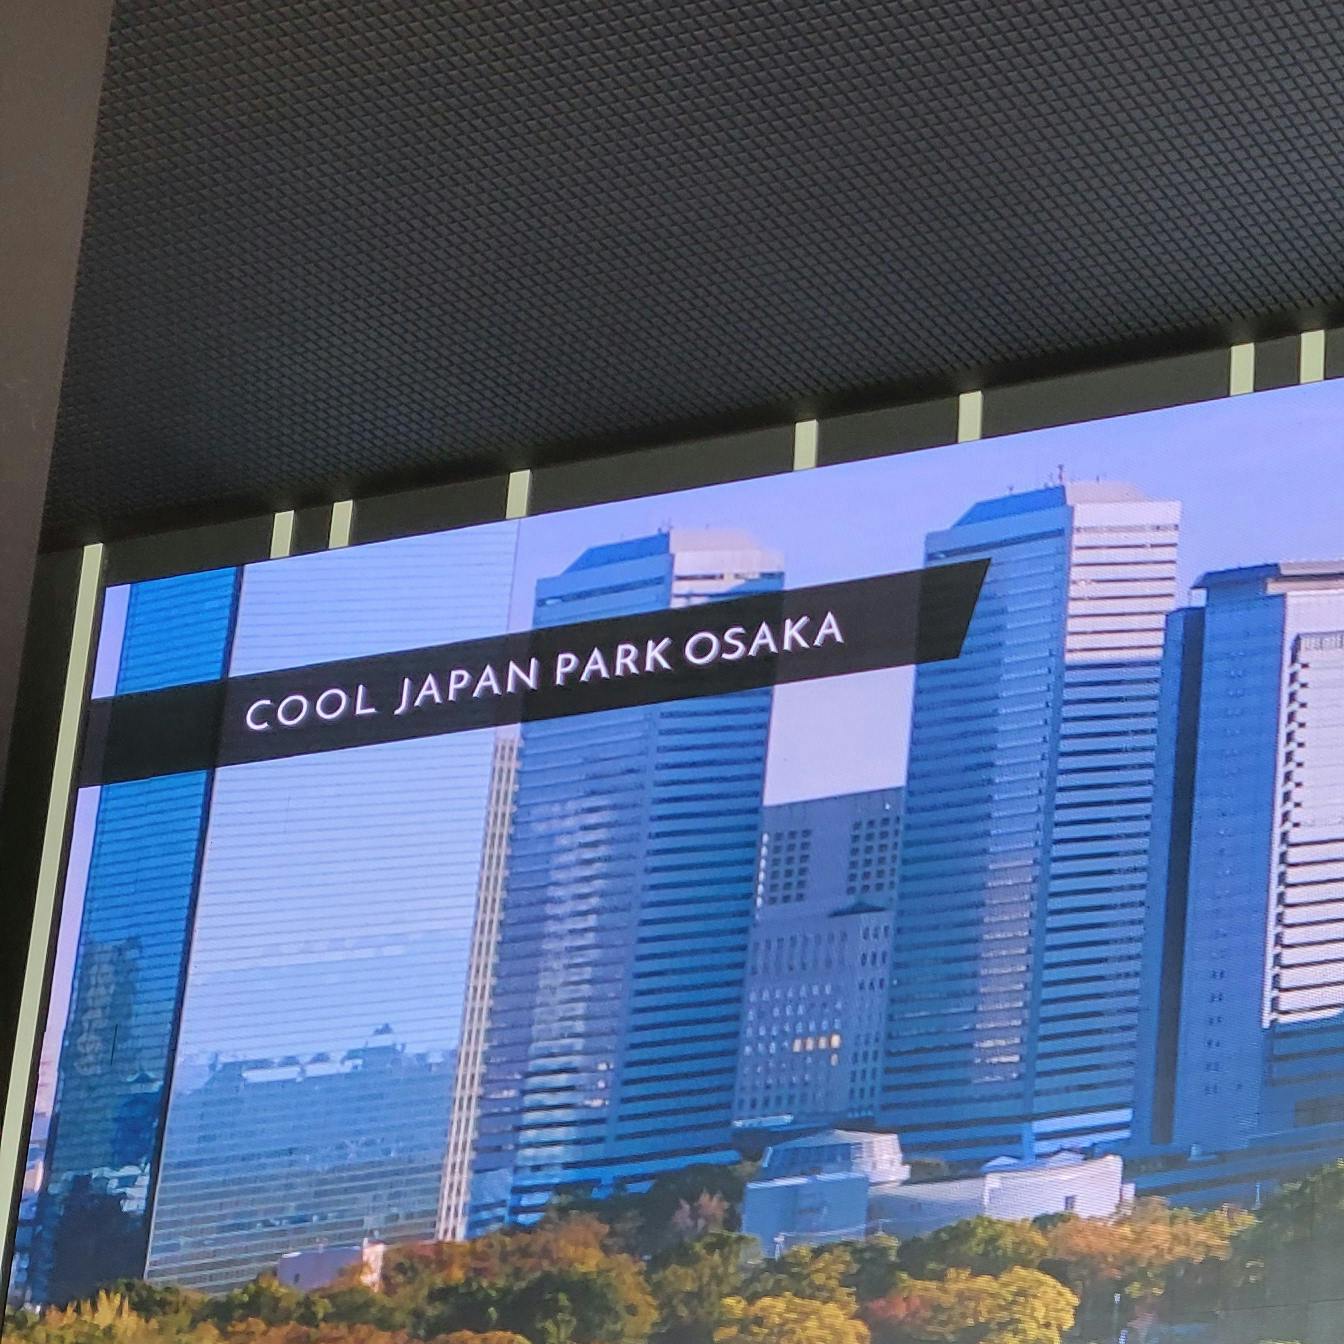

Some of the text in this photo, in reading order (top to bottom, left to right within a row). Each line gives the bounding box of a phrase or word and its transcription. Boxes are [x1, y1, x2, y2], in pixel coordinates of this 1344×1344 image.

[246, 611, 844, 731] COOL JAPAN PARK OSAKA
